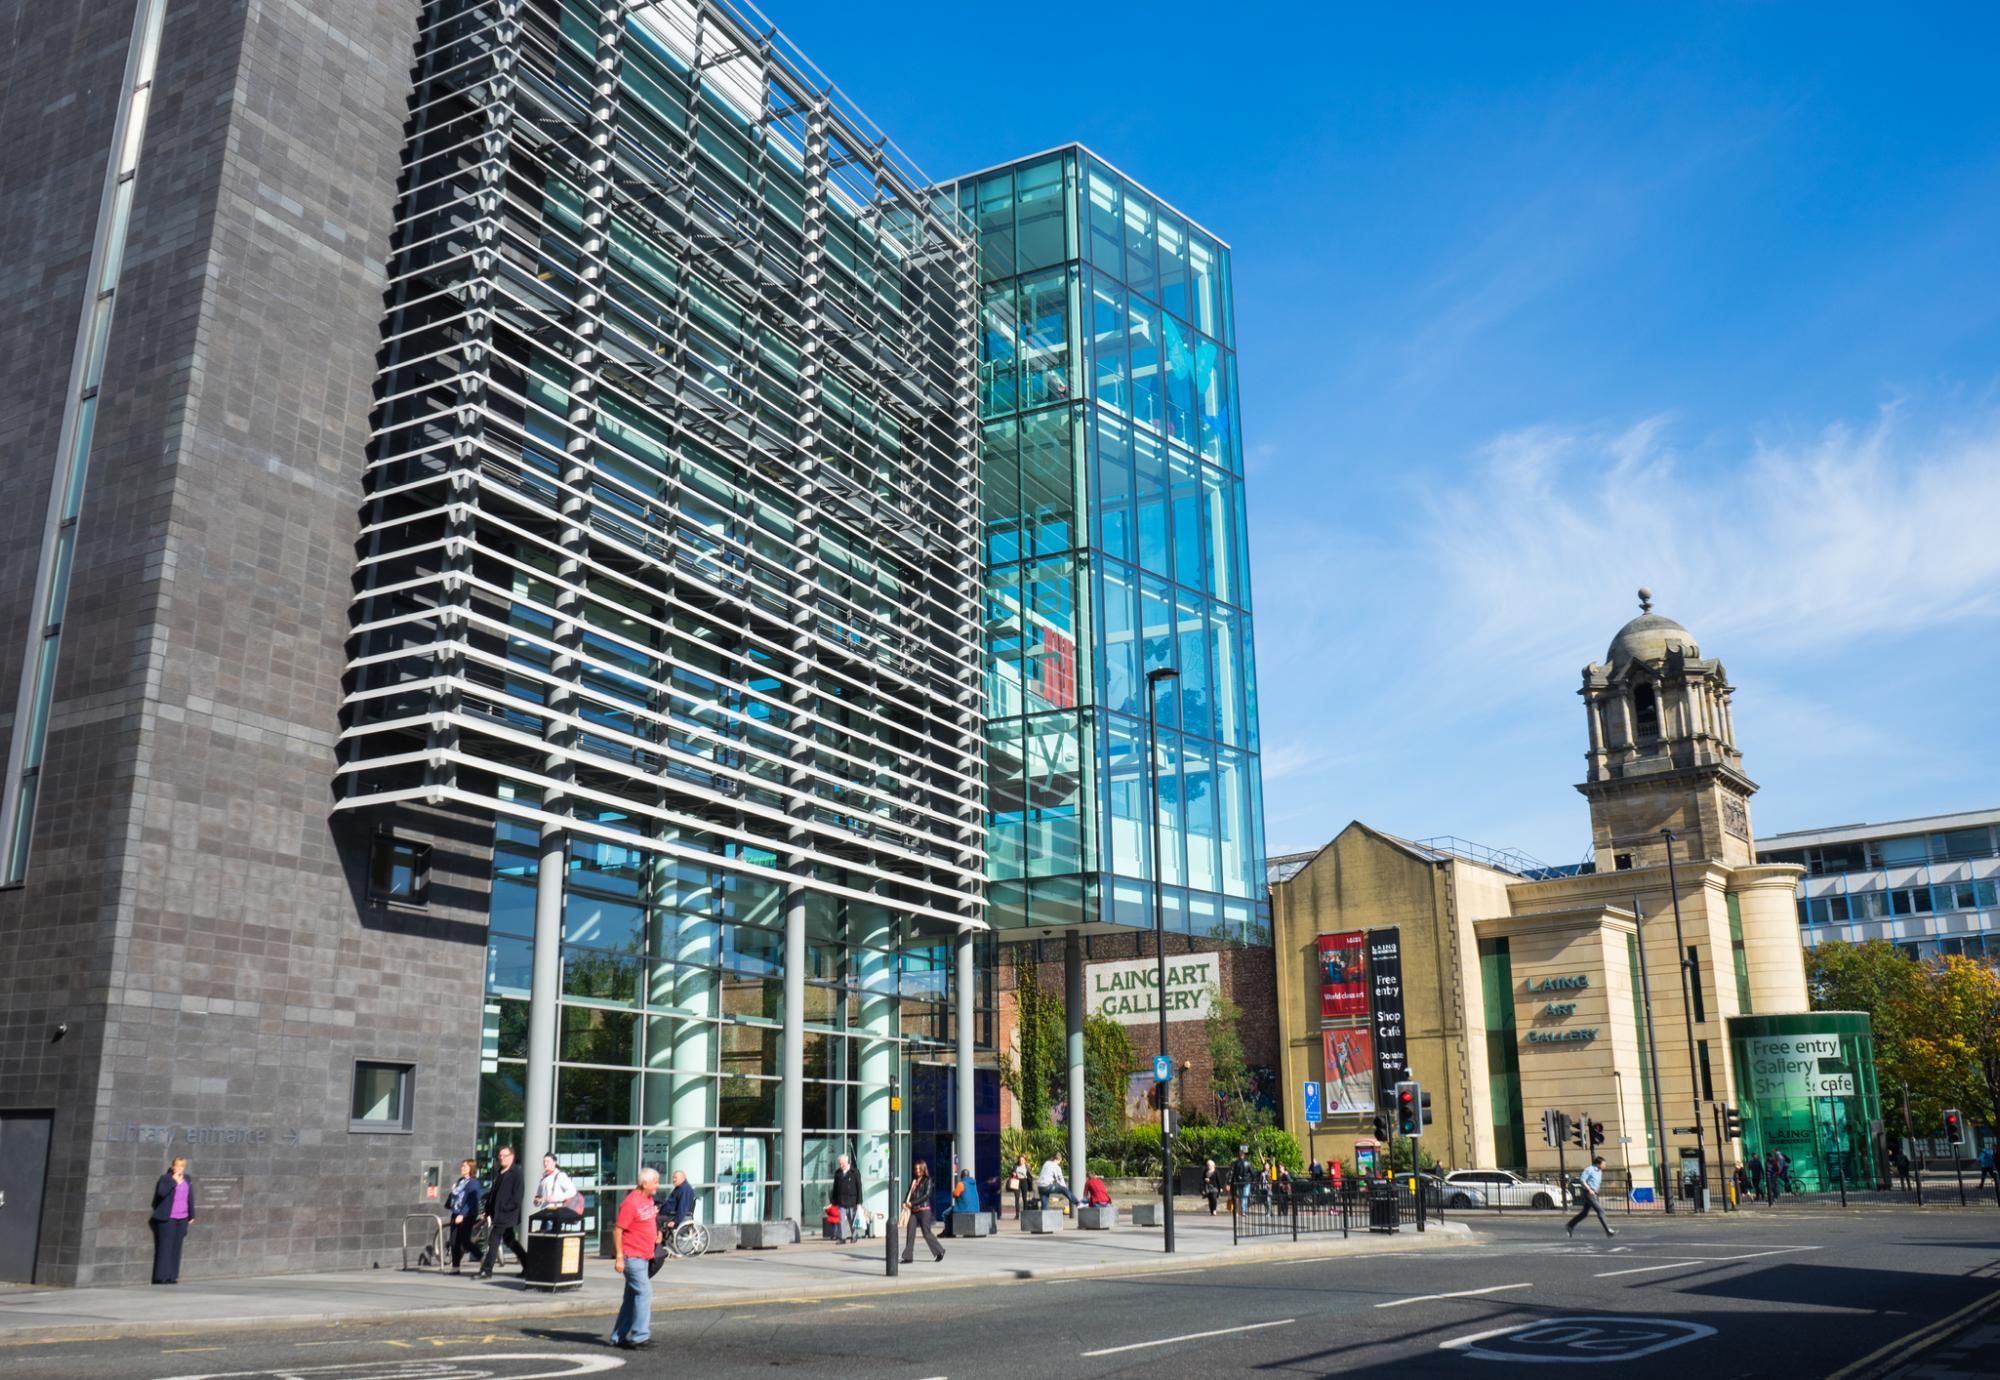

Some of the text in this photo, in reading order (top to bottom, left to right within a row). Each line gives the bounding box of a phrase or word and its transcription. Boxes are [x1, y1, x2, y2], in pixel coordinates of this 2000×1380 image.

[1165, 963, 1210, 986] ART
[1376, 975, 1397, 985] Free
[1375, 986, 1399, 997] entry
[1526, 975, 1589, 992] LAING
[1102, 988, 1204, 1016] GALLERY
[1545, 1000, 1576, 1017] ART
[1377, 1011, 1401, 1023] Shop
[1526, 1028, 1599, 1043] GALLERY
[1380, 1051, 1404, 1060] Donate
[1753, 1040, 1837, 1057] Free entry
[1382, 1061, 1402, 1070] today
[1753, 1058, 1814, 1076] Gallery
[1820, 1075, 1852, 1091] cafe
[107, 1119, 266, 1146] Library entrance
[1767, 1129, 1811, 1139] LAING
